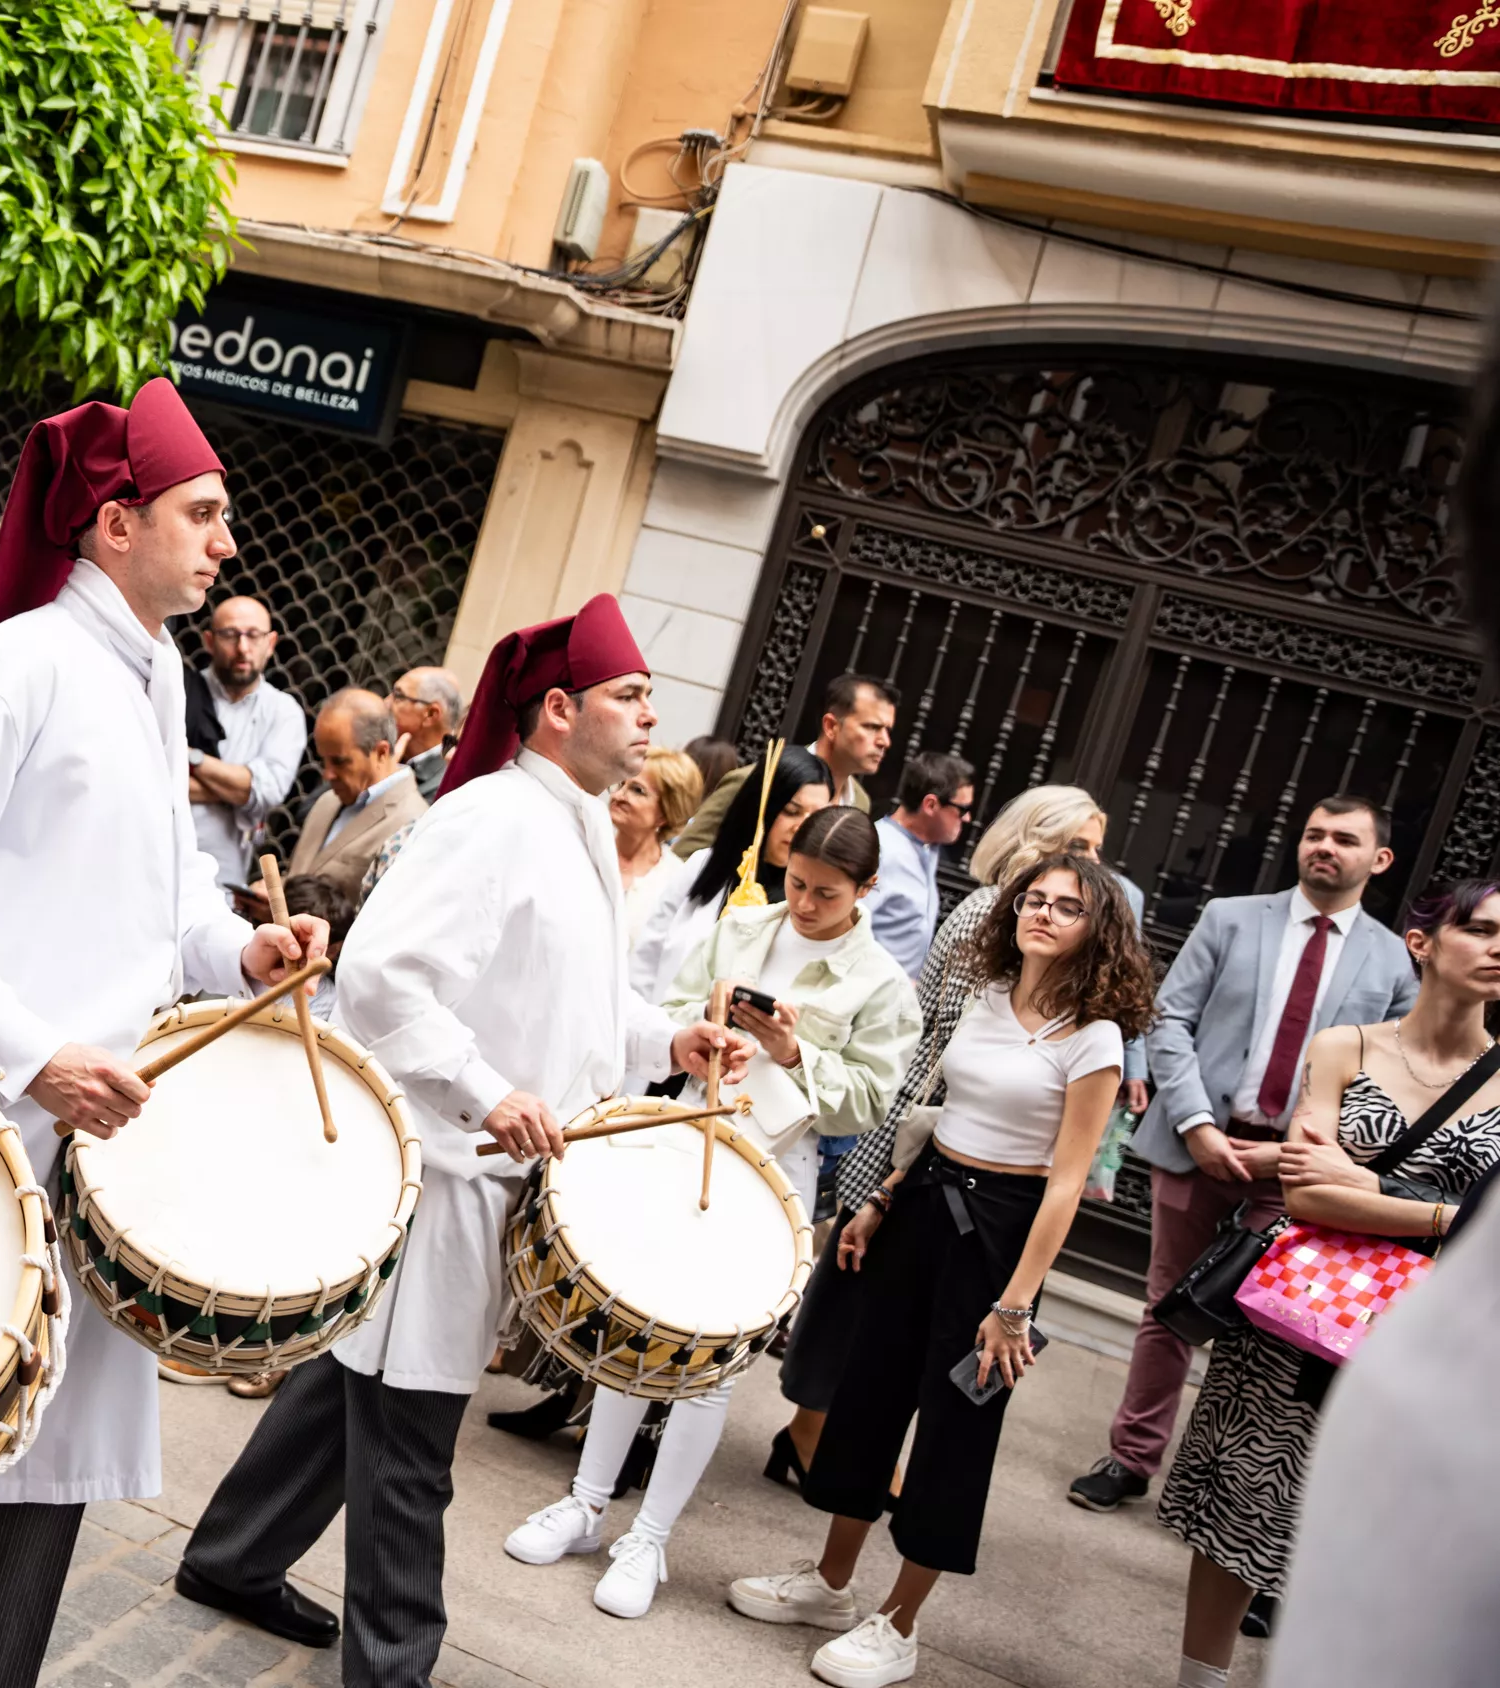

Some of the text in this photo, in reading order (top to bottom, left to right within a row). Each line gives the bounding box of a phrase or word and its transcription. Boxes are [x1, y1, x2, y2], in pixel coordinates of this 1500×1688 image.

[204, 368, 270, 393] MÉDICOS
[271, 382, 294, 398] DE
[294, 386, 360, 412] BELLEZA
